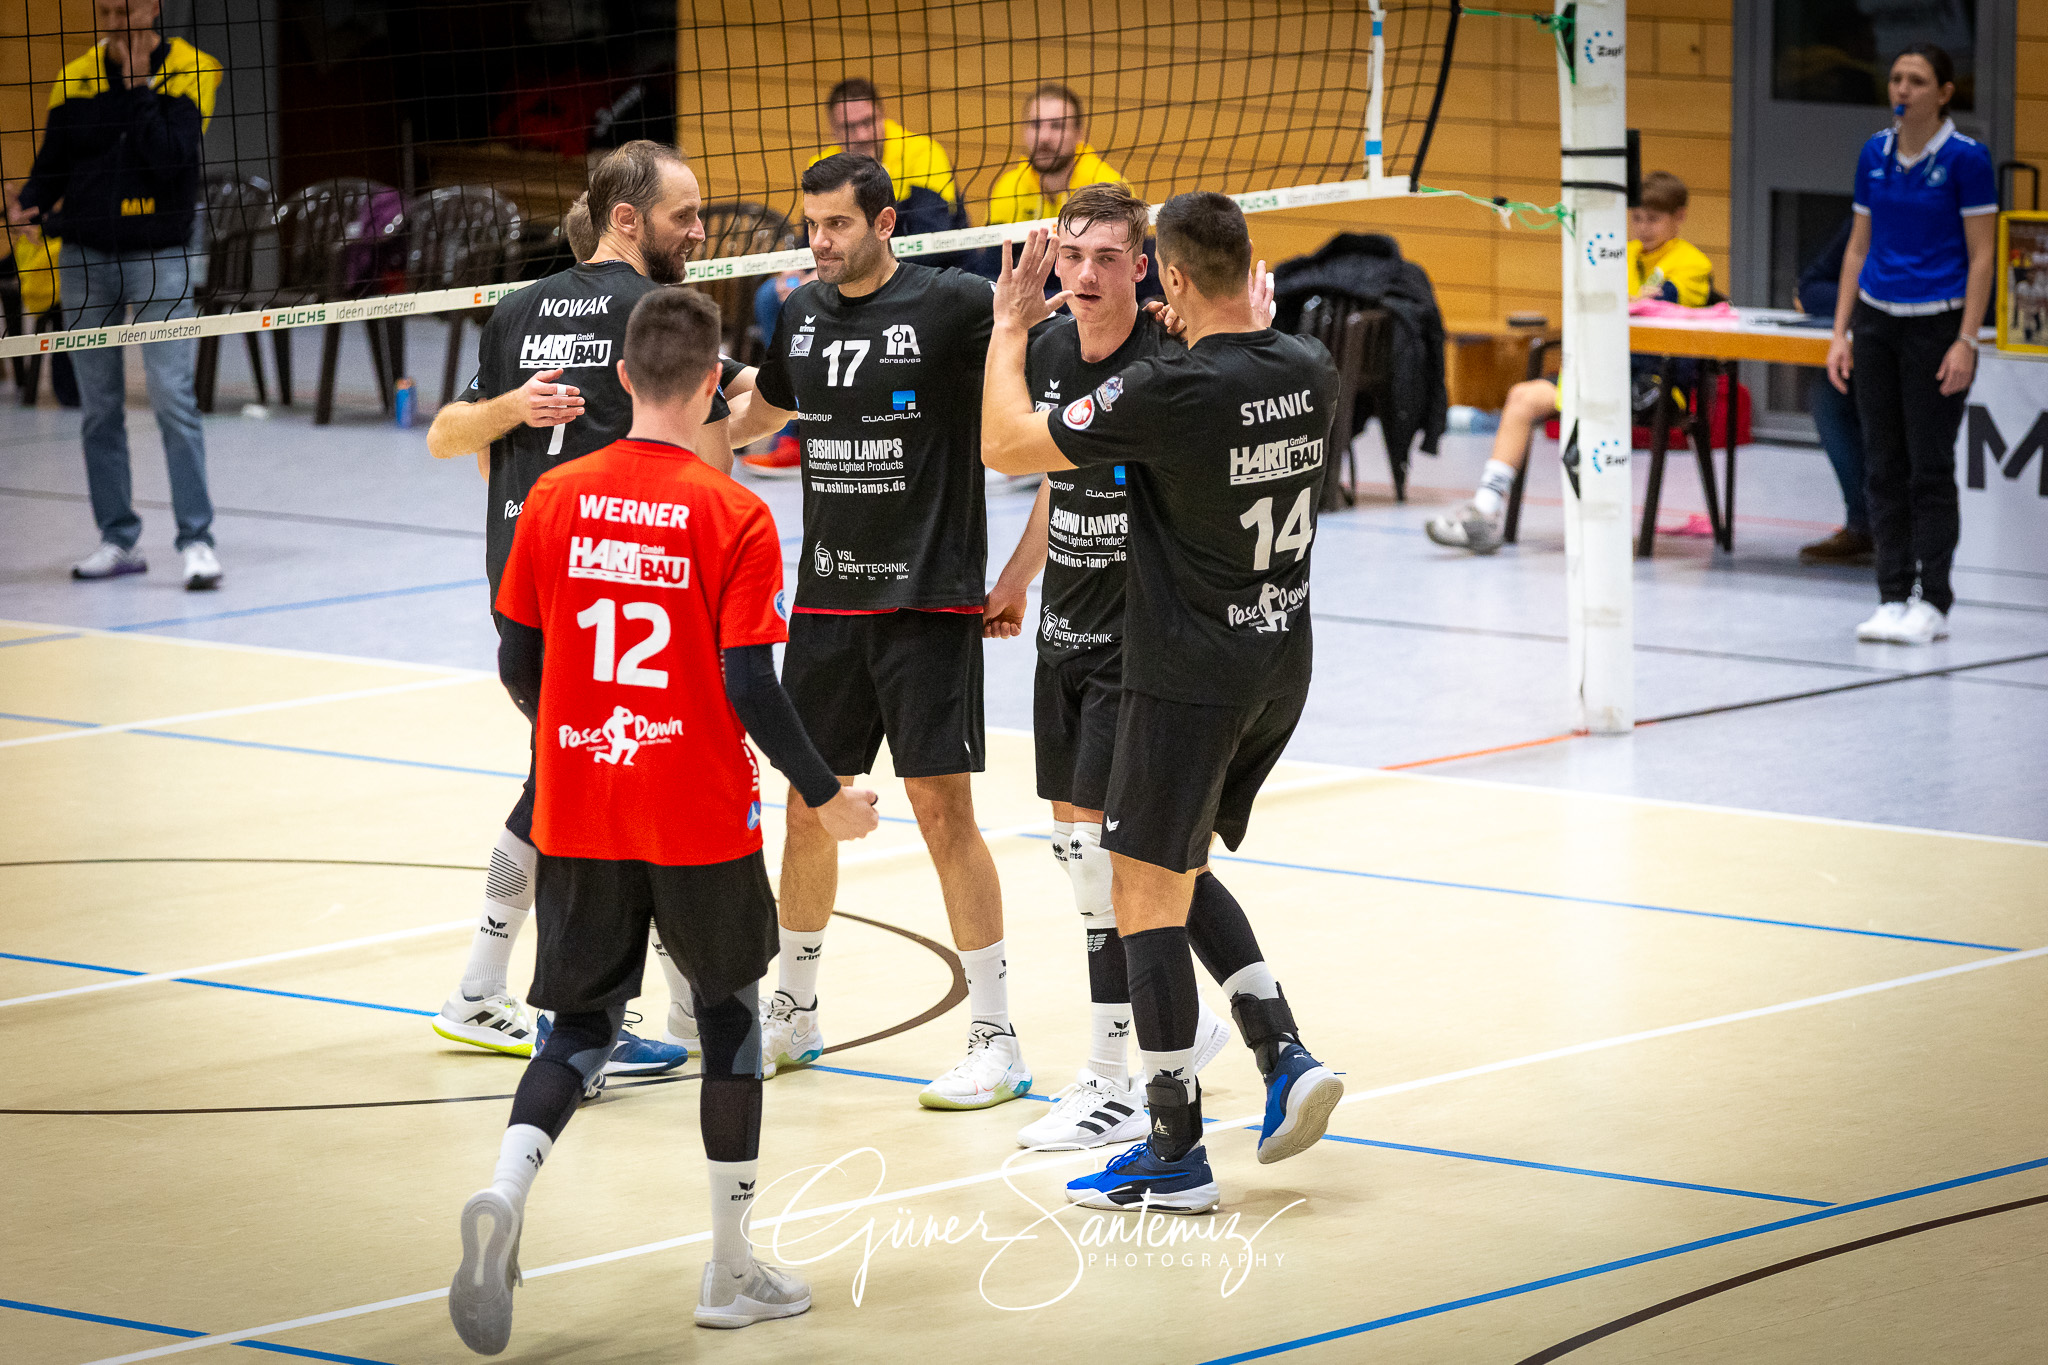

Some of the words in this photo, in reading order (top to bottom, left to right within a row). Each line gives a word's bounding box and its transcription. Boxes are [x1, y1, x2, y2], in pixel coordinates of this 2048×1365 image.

[688, 264, 733, 279] FUCHS
[276, 309, 326, 327] FUCHS
[336, 306, 363, 320] Ideen
[366, 300, 416, 317] umsetzen
[538, 295, 613, 318] NOWAK
[55, 332, 107, 350] FUCHS
[117, 330, 147, 343] Ideen
[149, 324, 201, 341] umsetzen
[520, 333, 577, 360] HART
[572, 343, 609, 364] BAU
[576, 332, 595, 341] GmbH
[821, 340, 871, 387] 17
[1240, 389, 1314, 426] STANIC
[854, 438, 903, 460] LAMPS
[1289, 434, 1308, 446] GmbH
[839, 461, 865, 474] Lighted
[867, 460, 904, 472] Products
[1230, 439, 1288, 475] HART
[1290, 443, 1321, 471] BAU
[811, 481, 906, 494] www.oshino-lamps.de
[580, 495, 690, 529] WERNER
[1081, 513, 1128, 535] LAMPS
[1240, 487, 1313, 571] 14
[1068, 536, 1093, 547] Lighted
[569, 536, 640, 574] HART
[640, 558, 686, 585] BAU
[837, 550, 855, 561] VSL
[1227, 604, 1260, 627] Pose
[577, 598, 671, 689] 12
[558, 724, 603, 749] Pose
[634, 714, 684, 741] Down
[480, 926, 509, 939] erima
